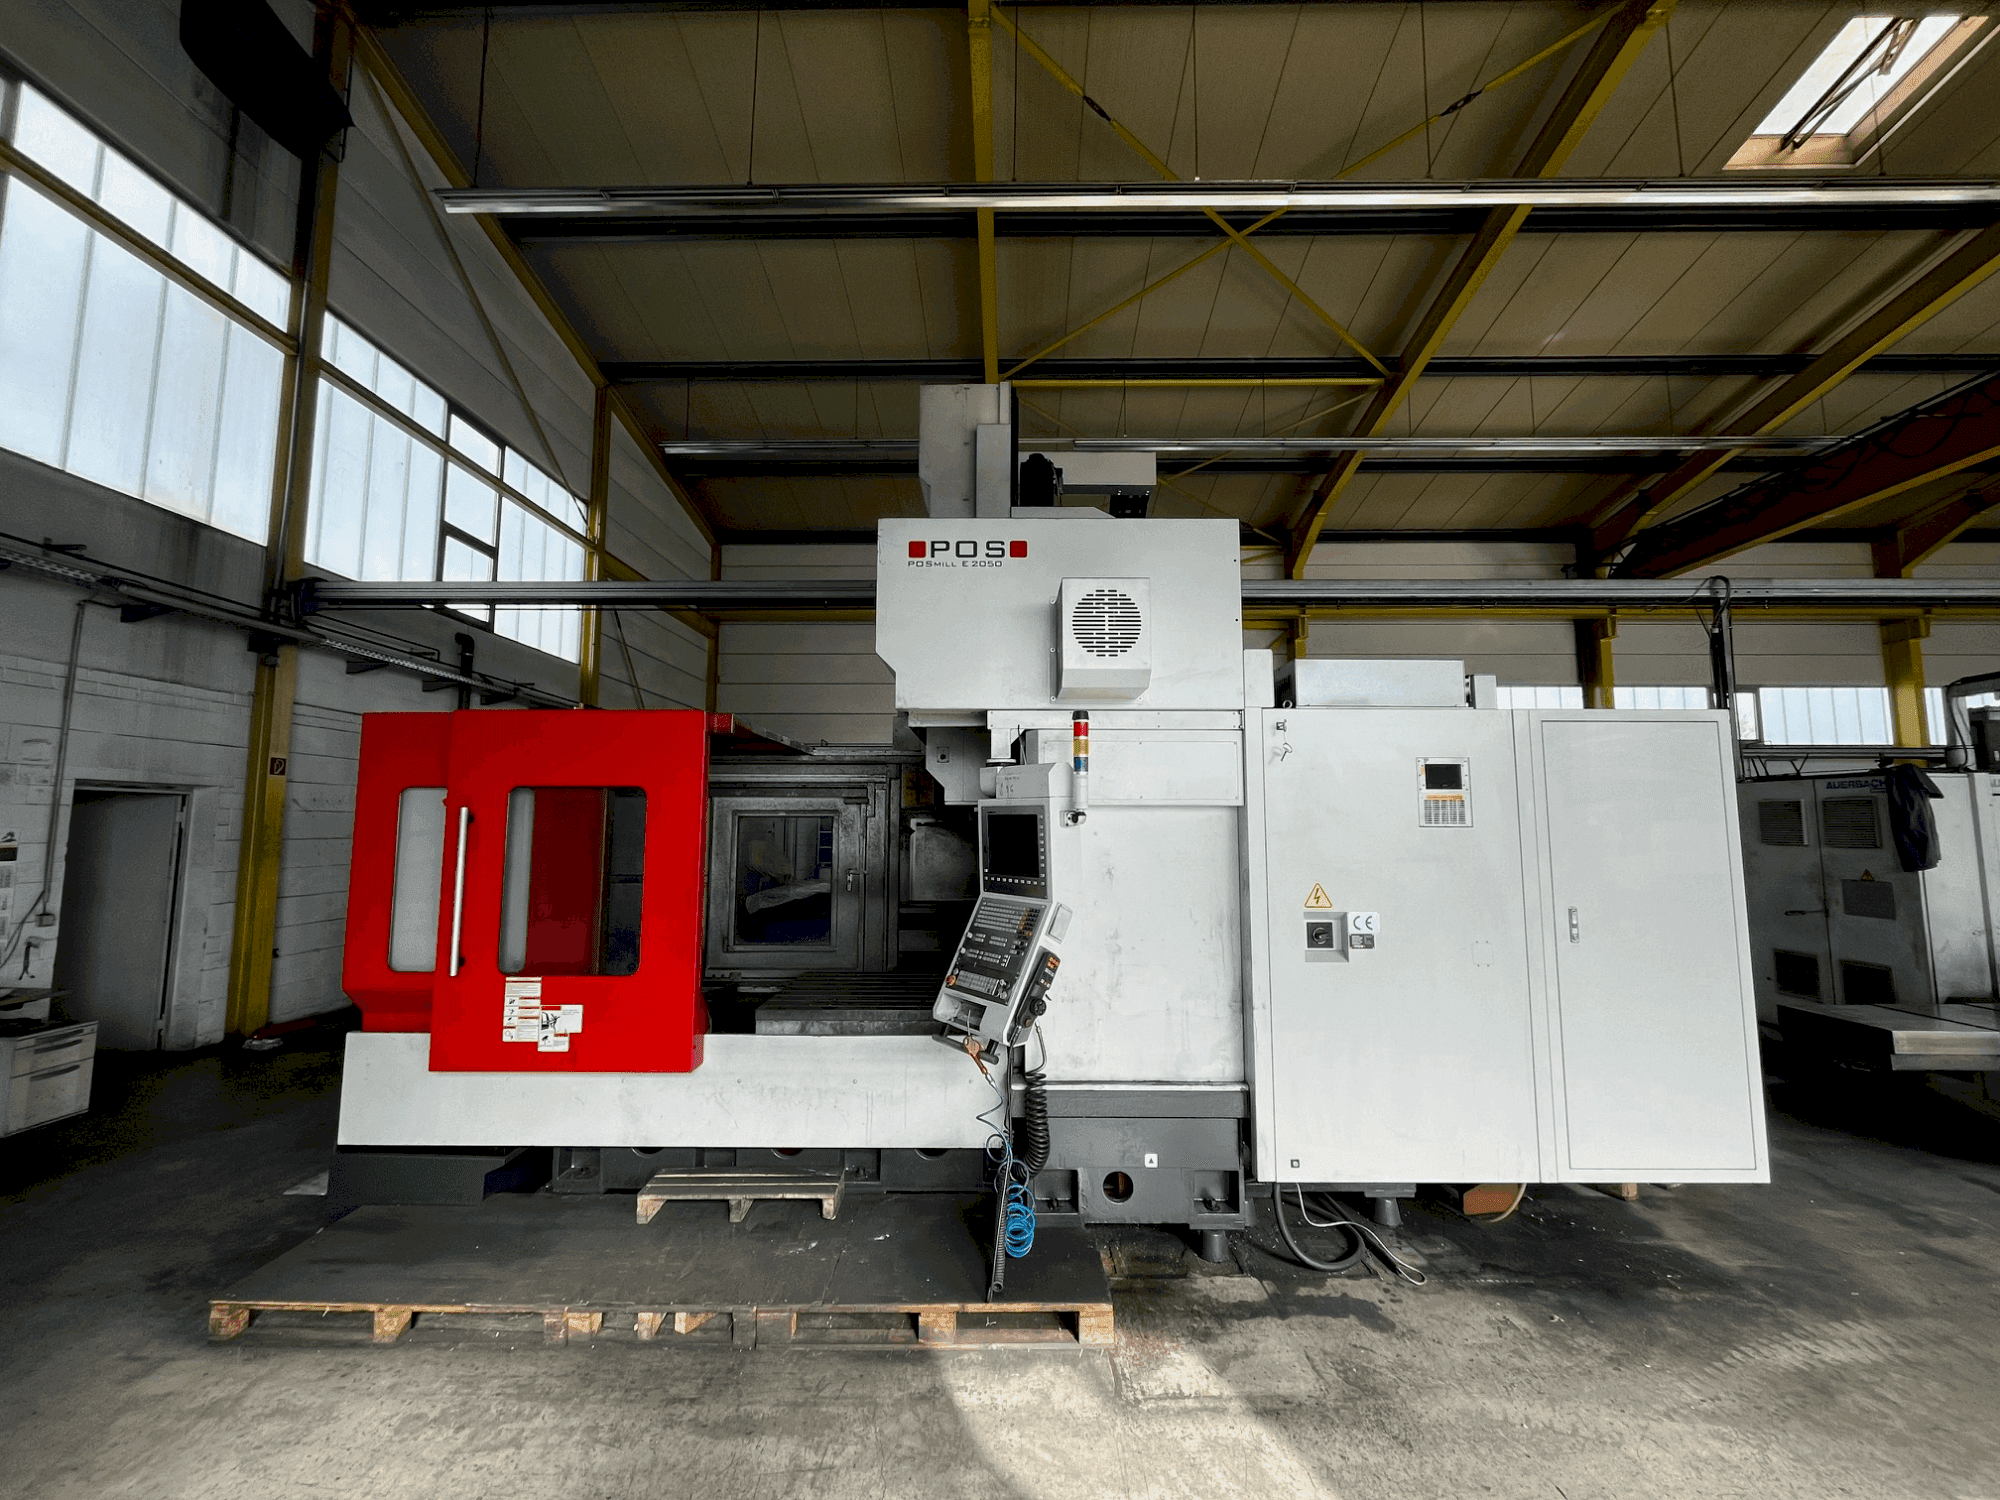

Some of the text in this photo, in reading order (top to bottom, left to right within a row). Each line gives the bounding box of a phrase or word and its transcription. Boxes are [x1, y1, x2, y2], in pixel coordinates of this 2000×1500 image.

[930, 540, 1006, 559] POS
[961, 560, 970, 568] E
[971, 560, 1003, 568] 2050
[1825, 779, 1887, 790] AUERBACH
[1353, 915, 1373, 930] CE
